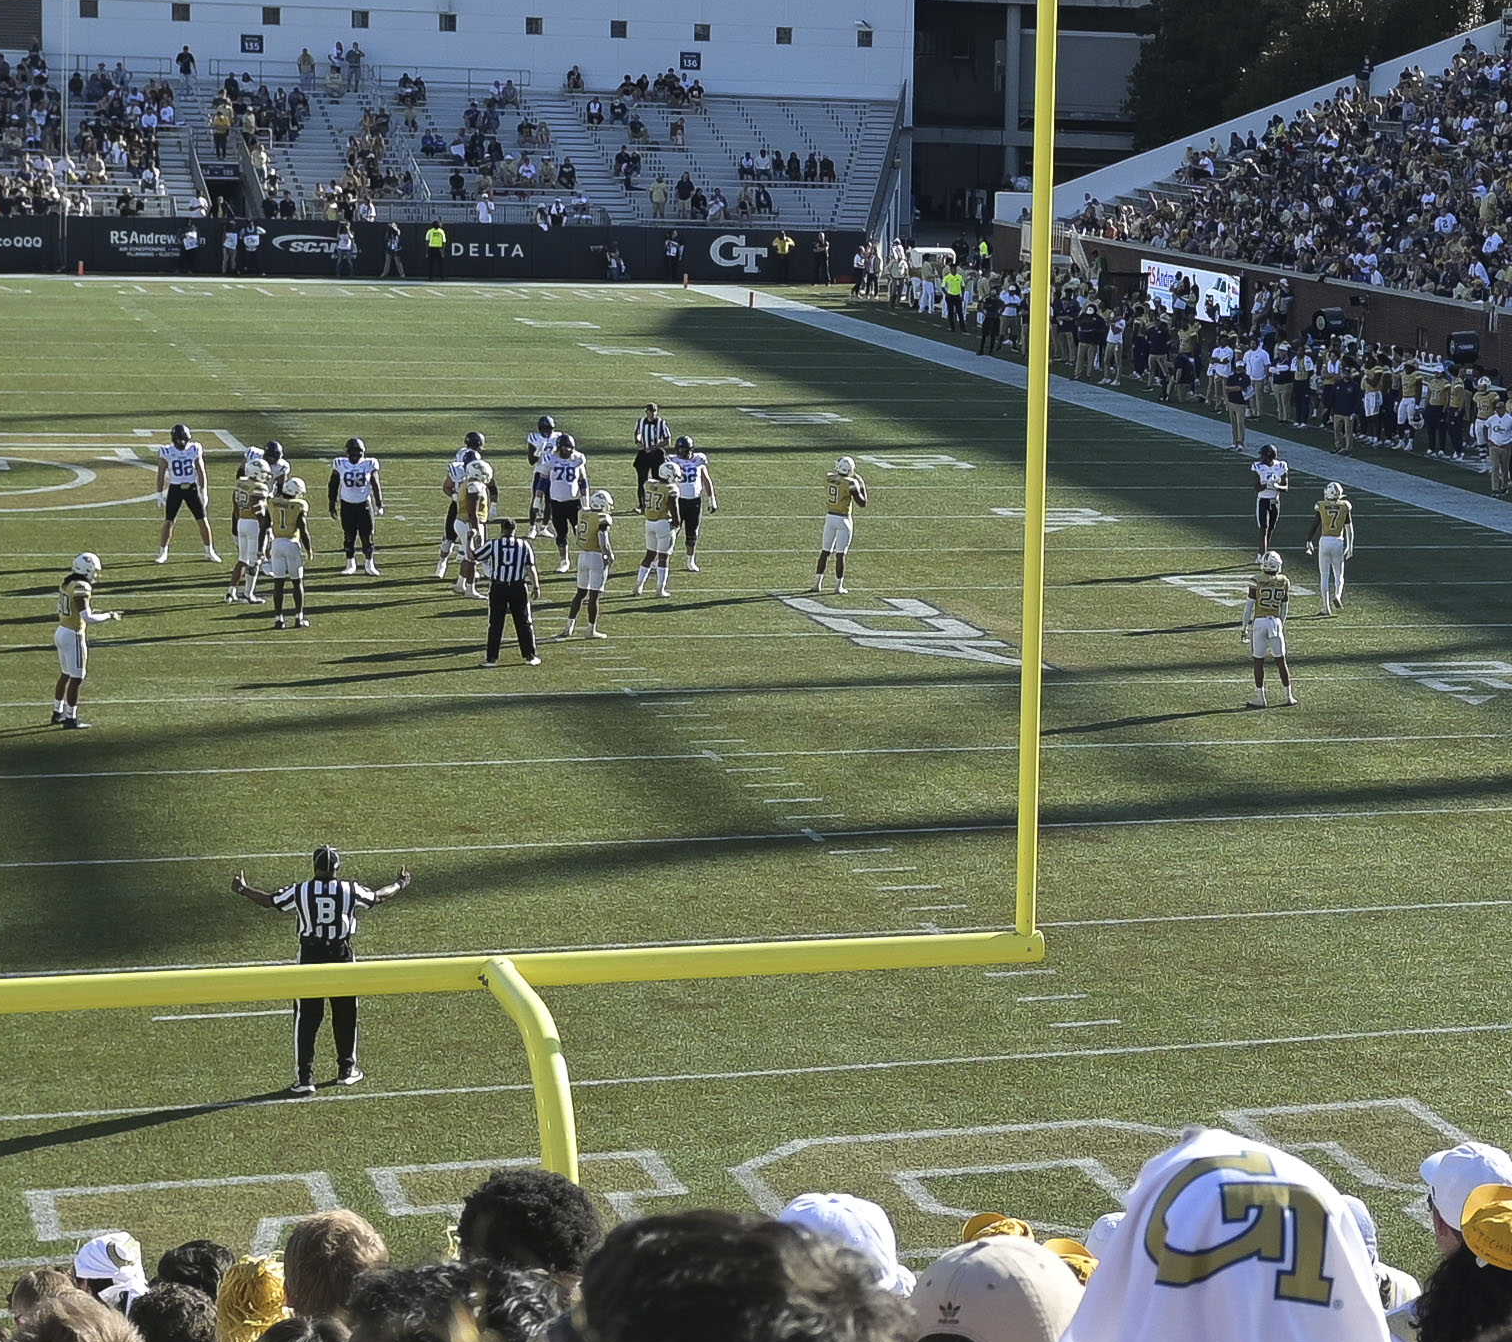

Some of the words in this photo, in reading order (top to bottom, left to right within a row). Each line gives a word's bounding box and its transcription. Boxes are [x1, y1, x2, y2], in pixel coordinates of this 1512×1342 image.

[451, 242, 525, 258] DELTA
[171, 459, 193, 477] 82
[553, 466, 575, 483] 78
[827, 485, 840, 504] 9
[279, 508, 287, 530] 1
[1327, 510, 1339, 528] 7
[503, 548, 514, 564] U
[314, 896, 337, 924] B
